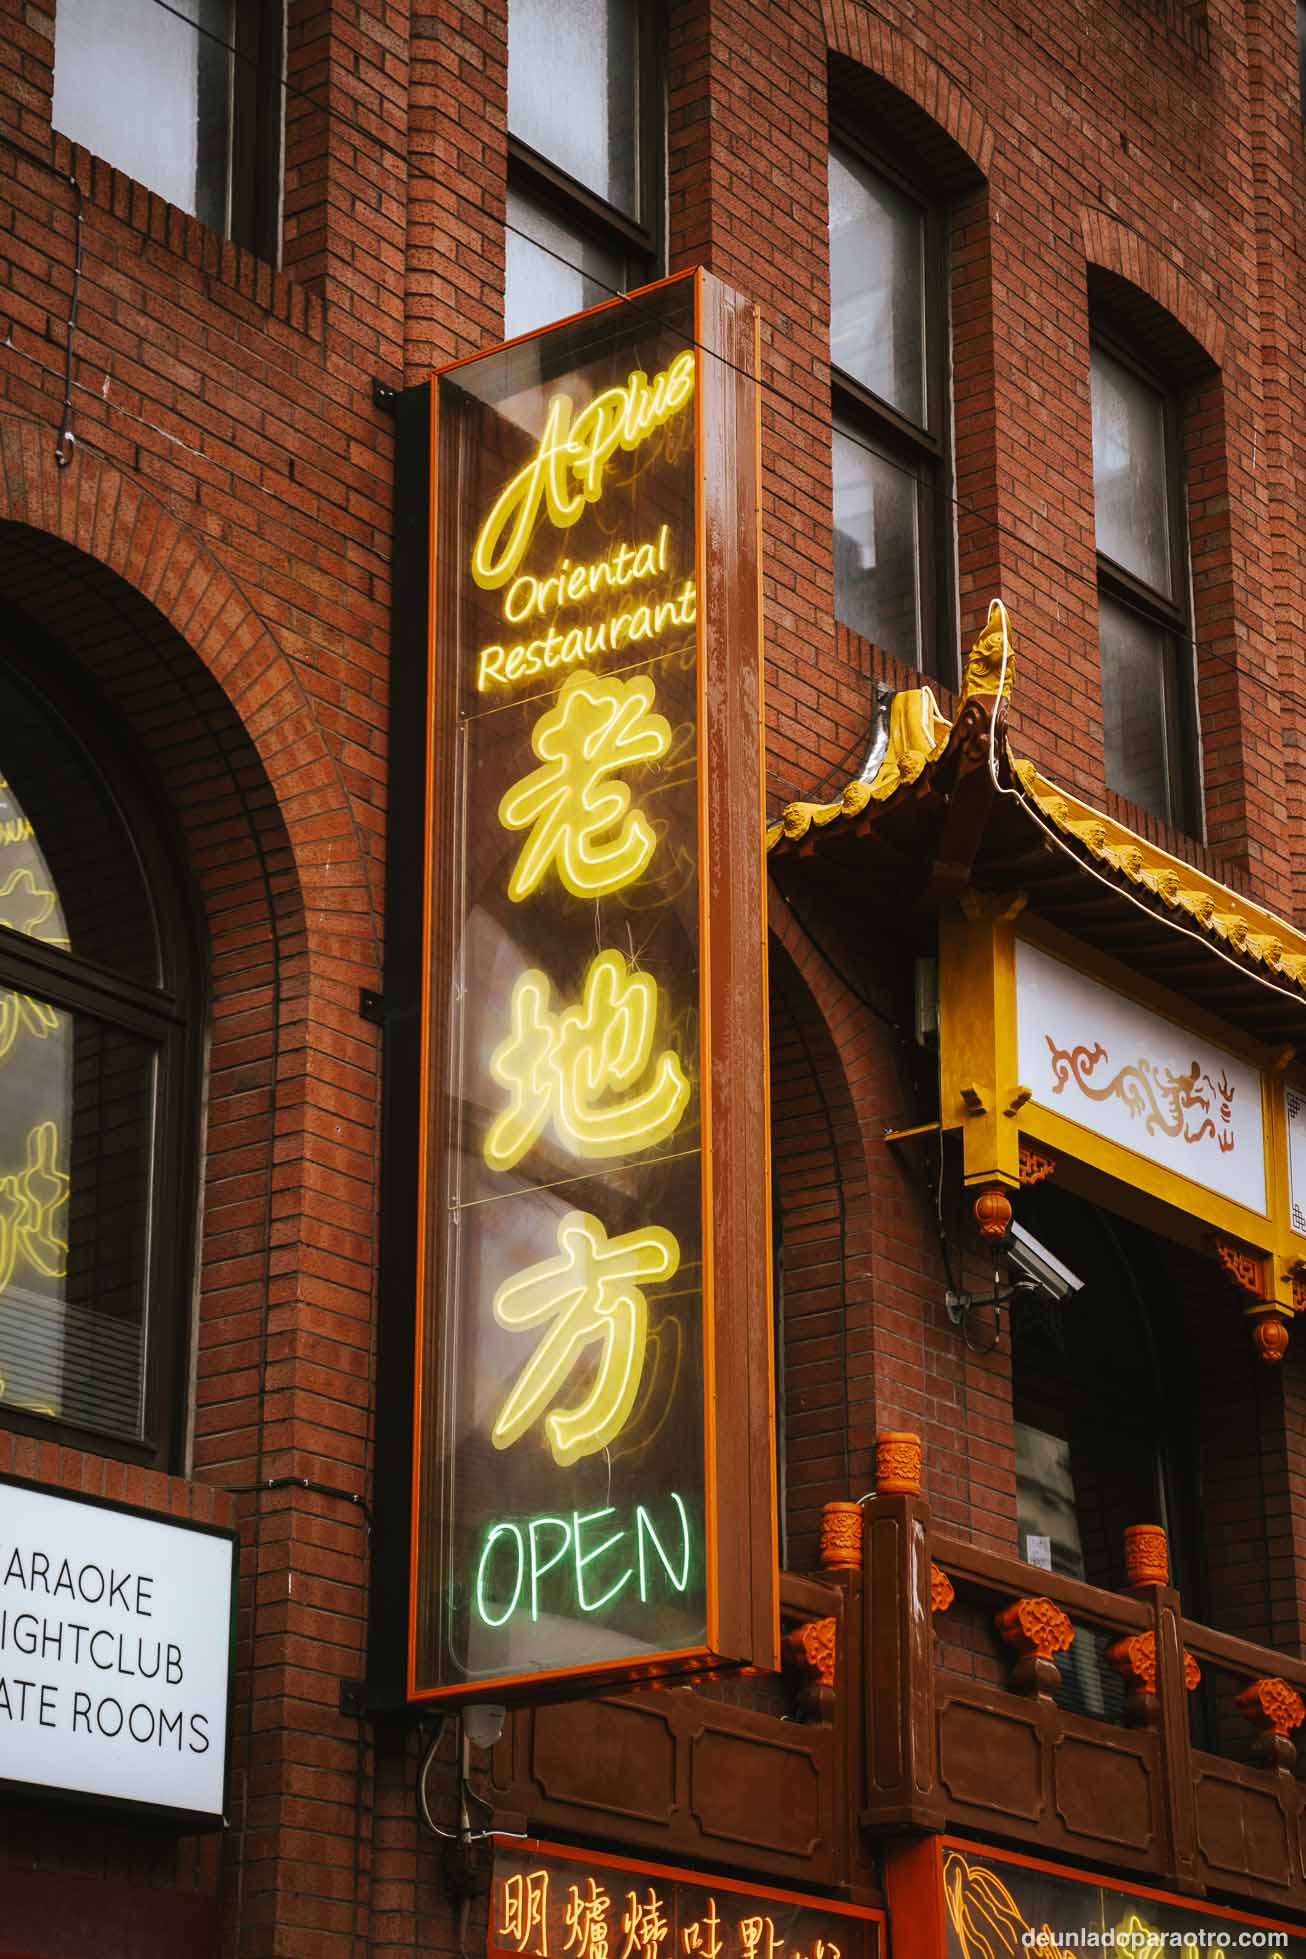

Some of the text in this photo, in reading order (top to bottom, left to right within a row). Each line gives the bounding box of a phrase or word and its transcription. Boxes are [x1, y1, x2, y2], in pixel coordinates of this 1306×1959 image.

[504, 524, 669, 624] Oriental
[477, 582, 697, 692] Restaurant
[482, 673, 689, 1464] 老地方
[477, 1492, 690, 1627] OPEN
[72, 1691, 210, 1754] ROOMS
